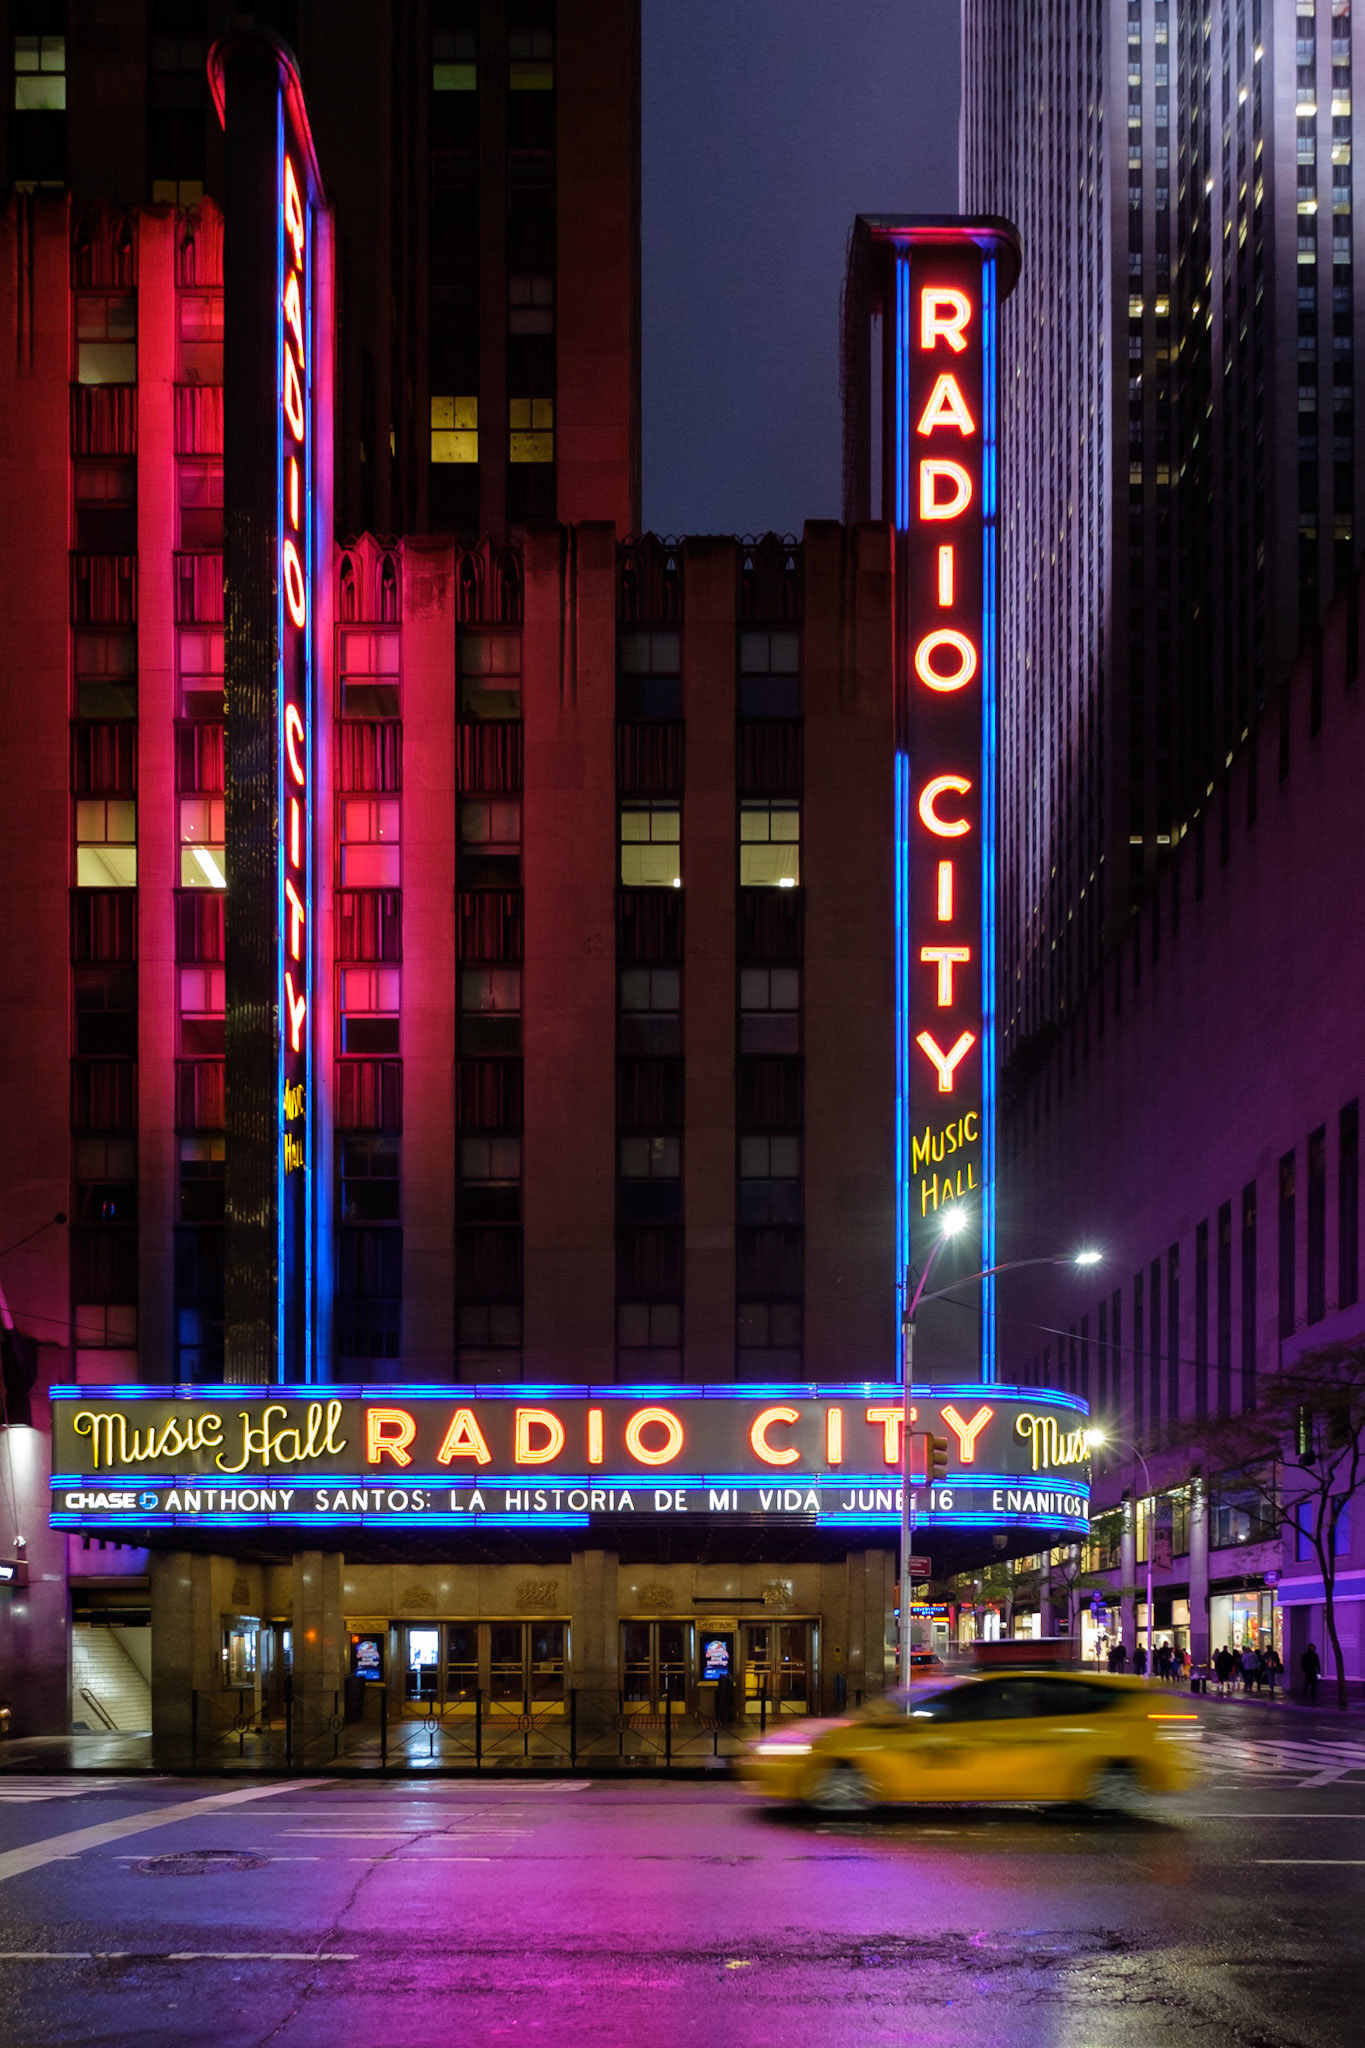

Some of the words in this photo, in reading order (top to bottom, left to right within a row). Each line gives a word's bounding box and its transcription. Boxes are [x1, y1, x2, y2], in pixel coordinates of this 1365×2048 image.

[284, 154, 306, 629] RADIO
[914, 285, 977, 693] RADIO
[285, 702, 306, 1053] CITY
[916, 774, 976, 1093] CITY
[921, 1163, 978, 1217] HALL
[73, 1411, 223, 1469] Music
[215, 1399, 347, 1473] Hall
[366, 1406, 684, 1467] RADIO
[750, 1405, 995, 1465] CITY
[65, 1492, 137, 1509] CHASE
[165, 1489, 295, 1511] ANTHONY
[315, 1489, 431, 1511] SANTOS:
[450, 1489, 486, 1511] LA
[505, 1489, 635, 1511] HISTORIA
[654, 1489, 688, 1511] DE
[709, 1489, 738, 1511] MI
[759, 1489, 821, 1511] VIDA
[930, 1489, 954, 1511] 16
[992, 1489, 1081, 1517] ENANITOS
